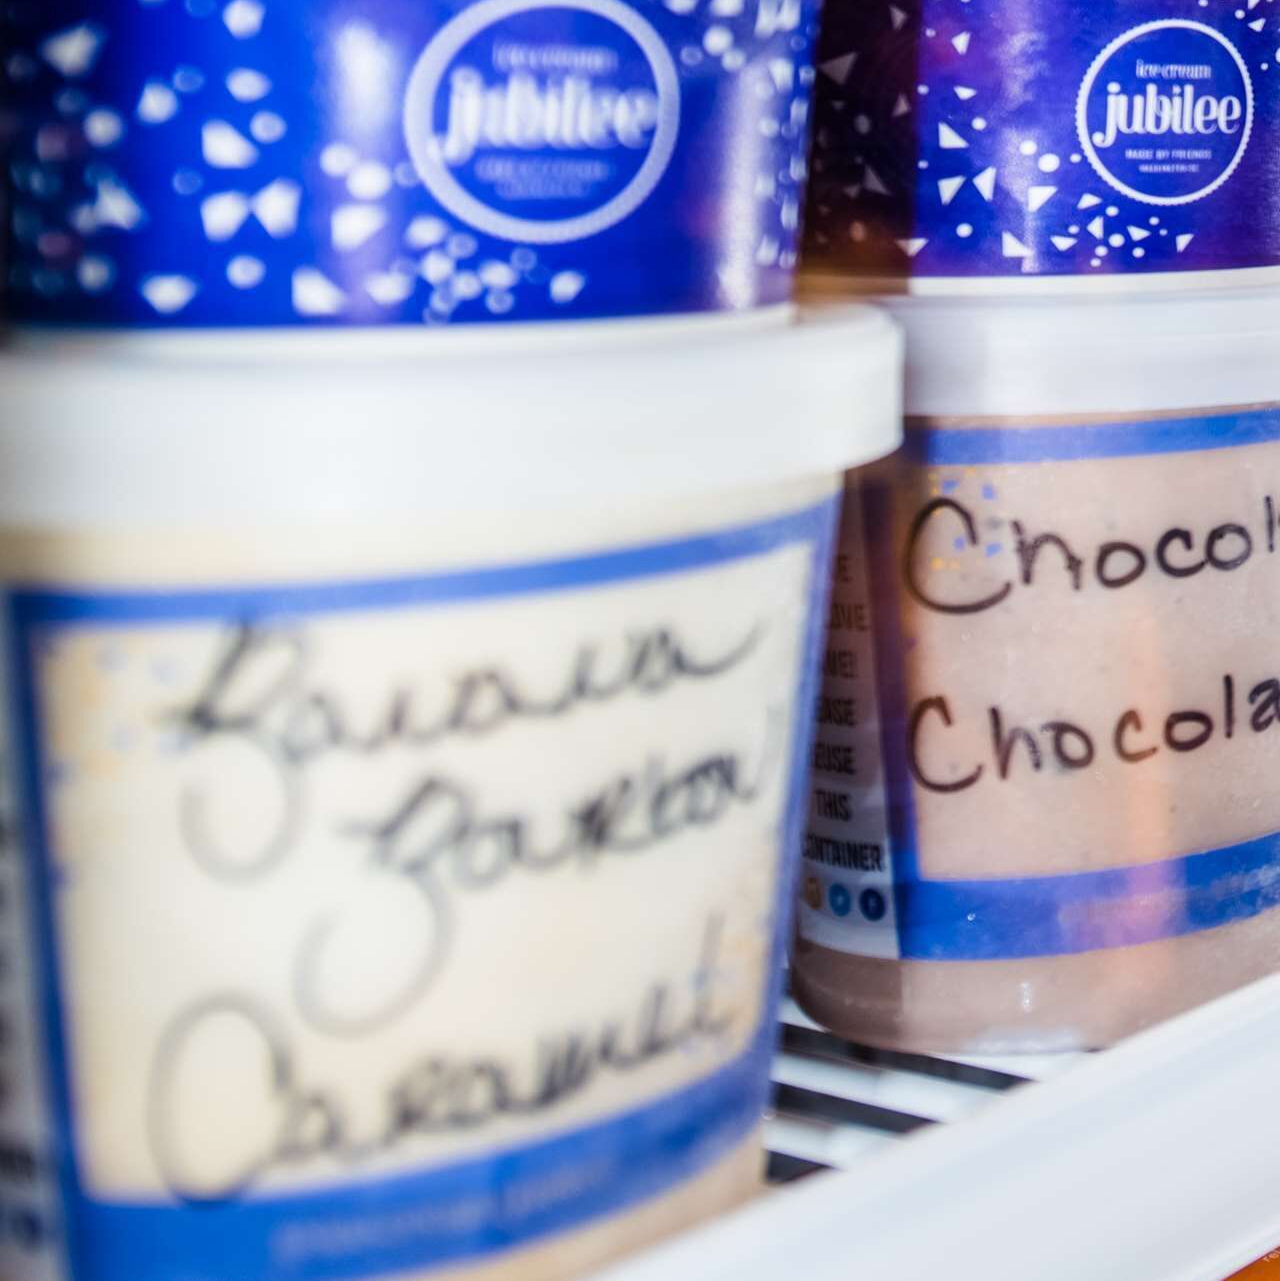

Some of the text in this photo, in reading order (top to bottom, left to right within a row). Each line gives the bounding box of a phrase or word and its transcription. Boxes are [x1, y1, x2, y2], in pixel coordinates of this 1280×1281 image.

[1092, 81, 1242, 148] jubilee
[815, 788, 852, 823] THIS
[802, 832, 884, 872] ONTAINER
